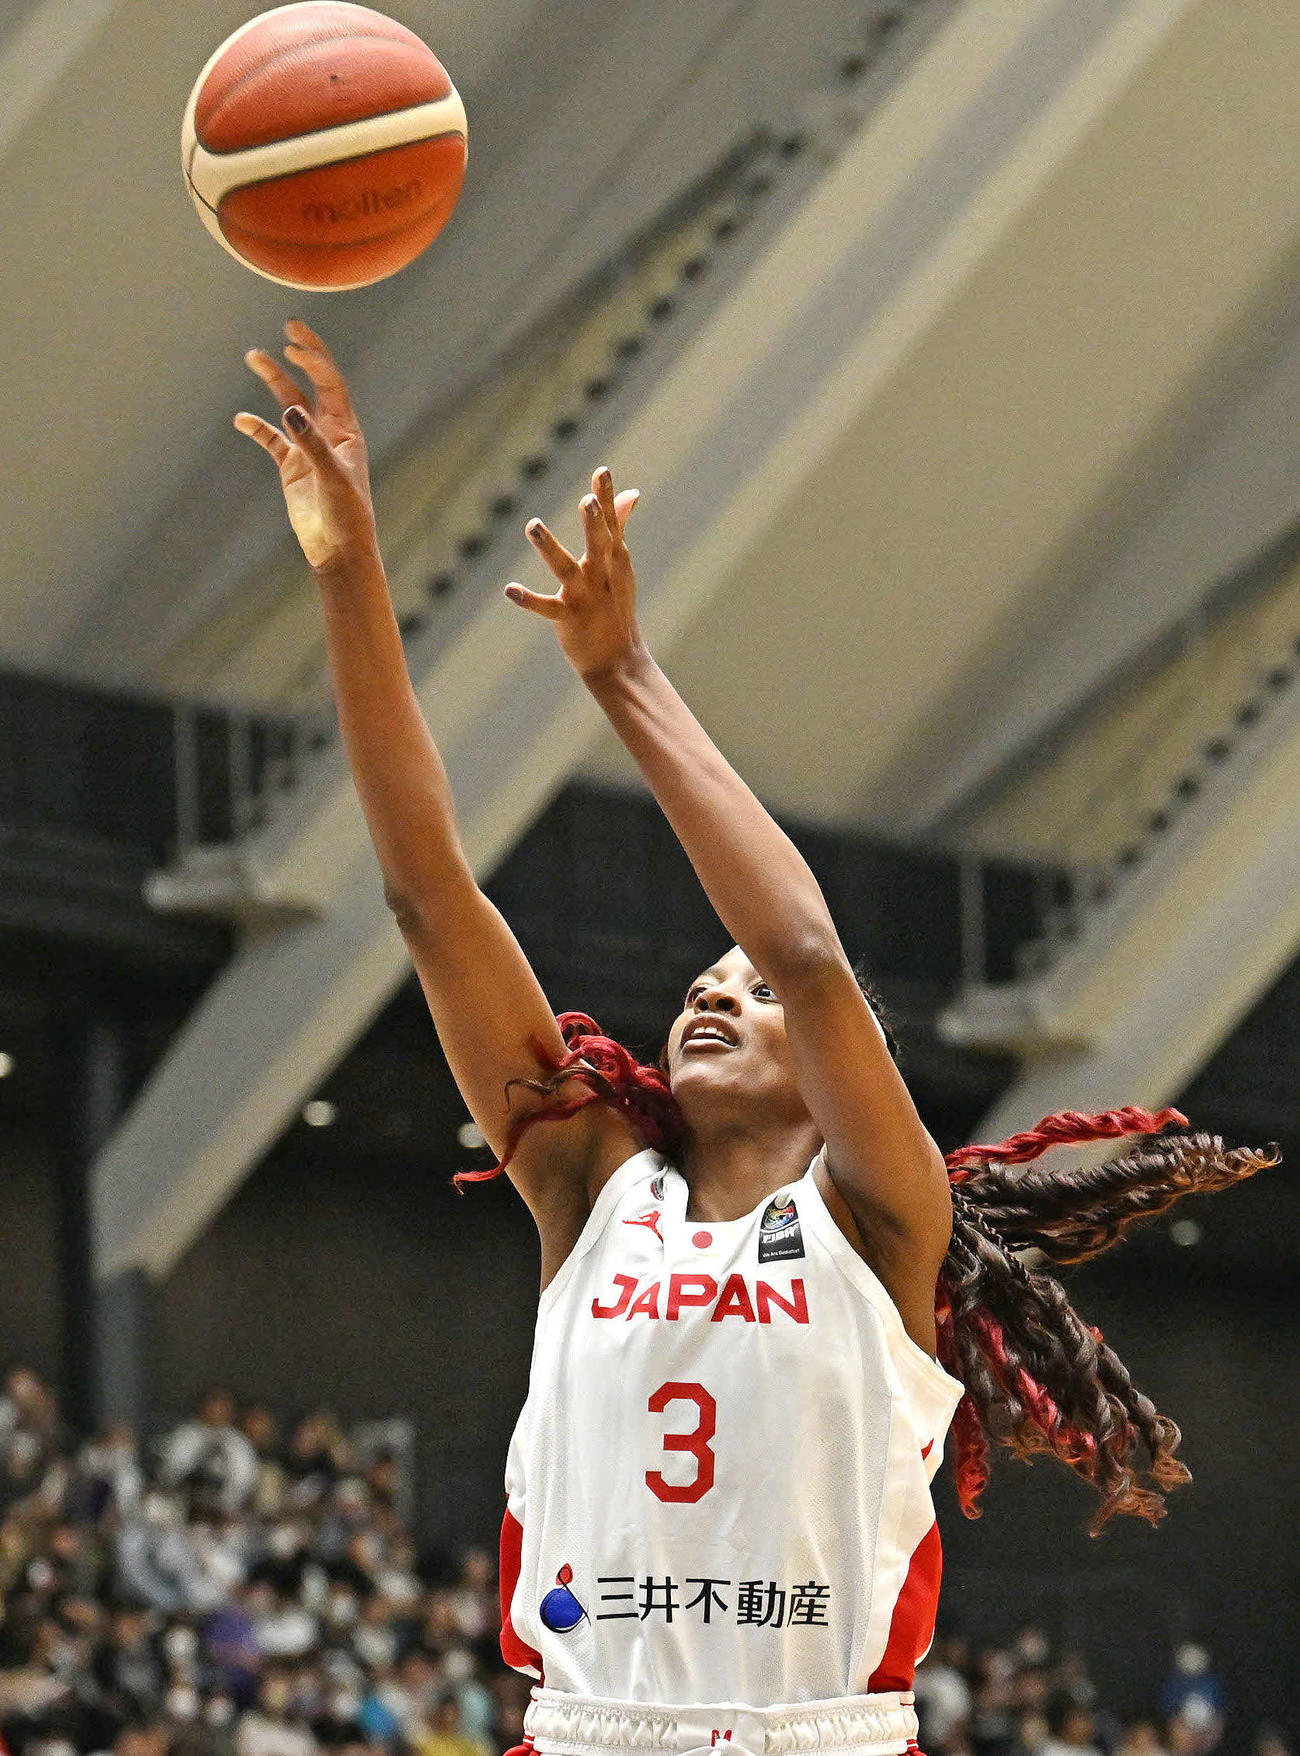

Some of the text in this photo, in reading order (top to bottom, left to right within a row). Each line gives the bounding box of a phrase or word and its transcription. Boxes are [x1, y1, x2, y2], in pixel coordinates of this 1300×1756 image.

[303, 180, 422, 222] molten
[592, 1273, 809, 1325] JAPAN
[645, 1381, 717, 1504] 3
[596, 1576, 831, 1629] 三井不動産
